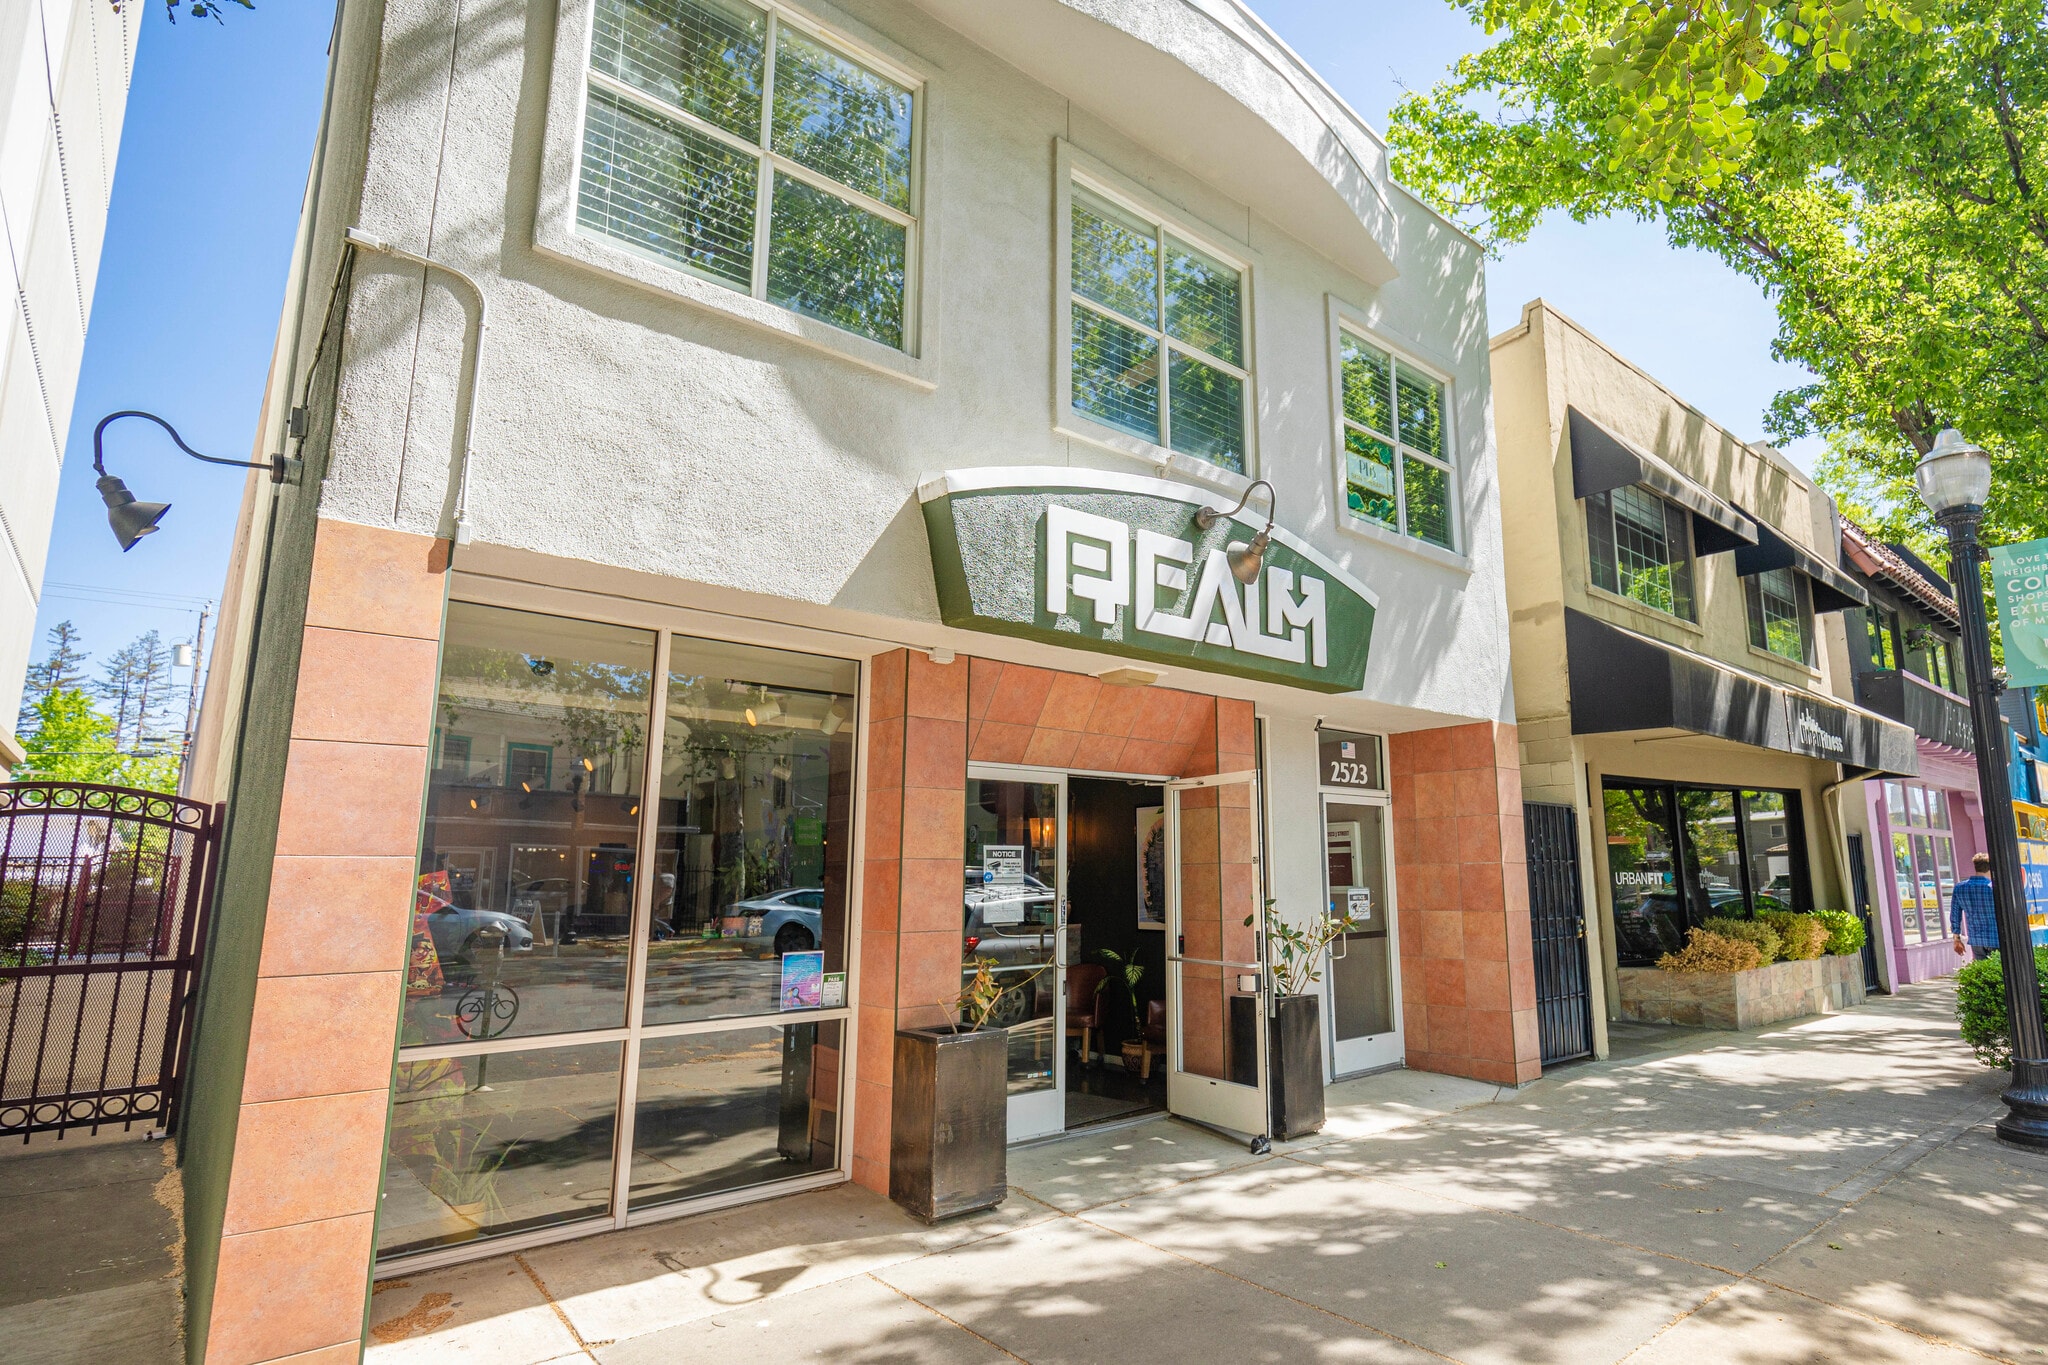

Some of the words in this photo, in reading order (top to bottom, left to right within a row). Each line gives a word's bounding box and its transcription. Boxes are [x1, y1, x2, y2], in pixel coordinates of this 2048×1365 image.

[2010, 554, 2040, 566] LOVE
[1046, 504, 1328, 668] REALM
[2011, 618, 2029, 628] OF
[1331, 761, 1368, 785] 2523
[1615, 871, 1664, 885] URBANFIT
